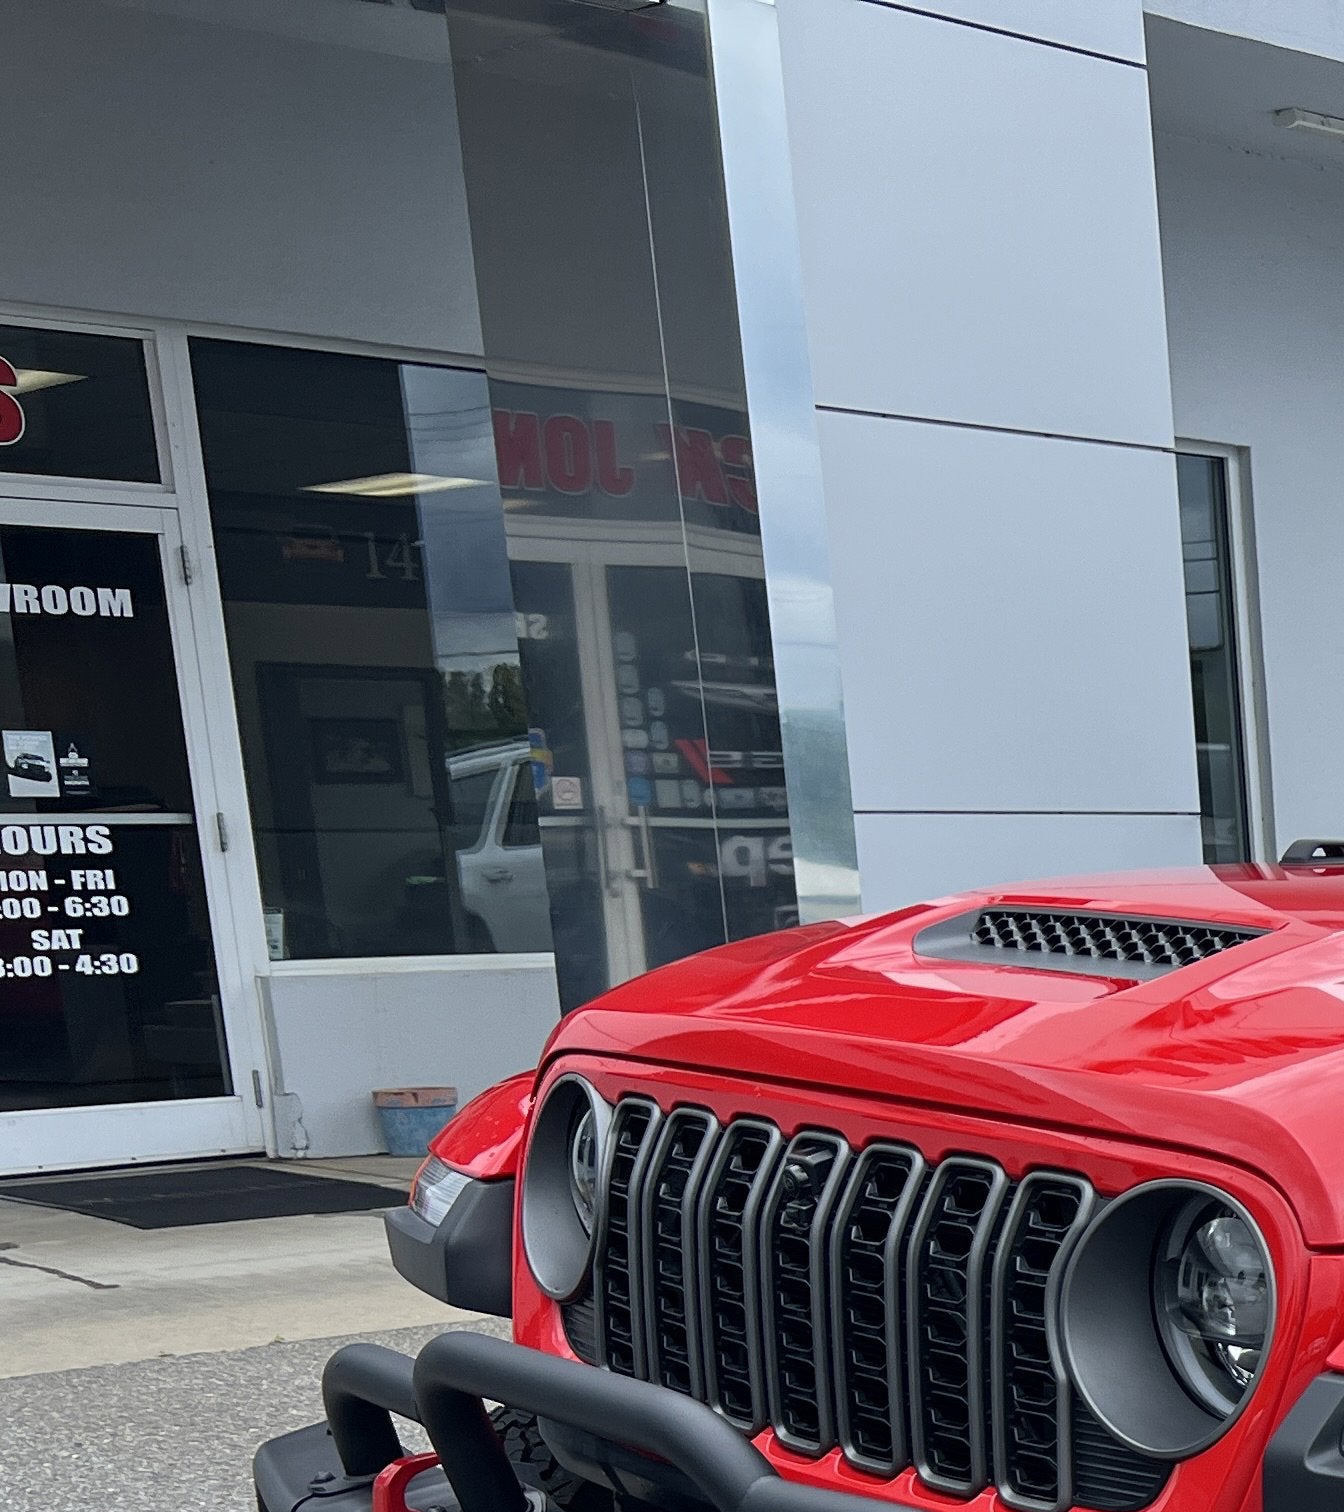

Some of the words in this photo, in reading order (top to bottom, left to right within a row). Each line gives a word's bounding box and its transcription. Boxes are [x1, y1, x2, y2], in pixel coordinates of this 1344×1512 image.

[0, 825, 113, 856] OURS
[70, 869, 116, 891] FRI
[64, 895, 130, 918] 6:30
[31, 928, 83, 951] SAT
[75, 953, 139, 975] 4:30
